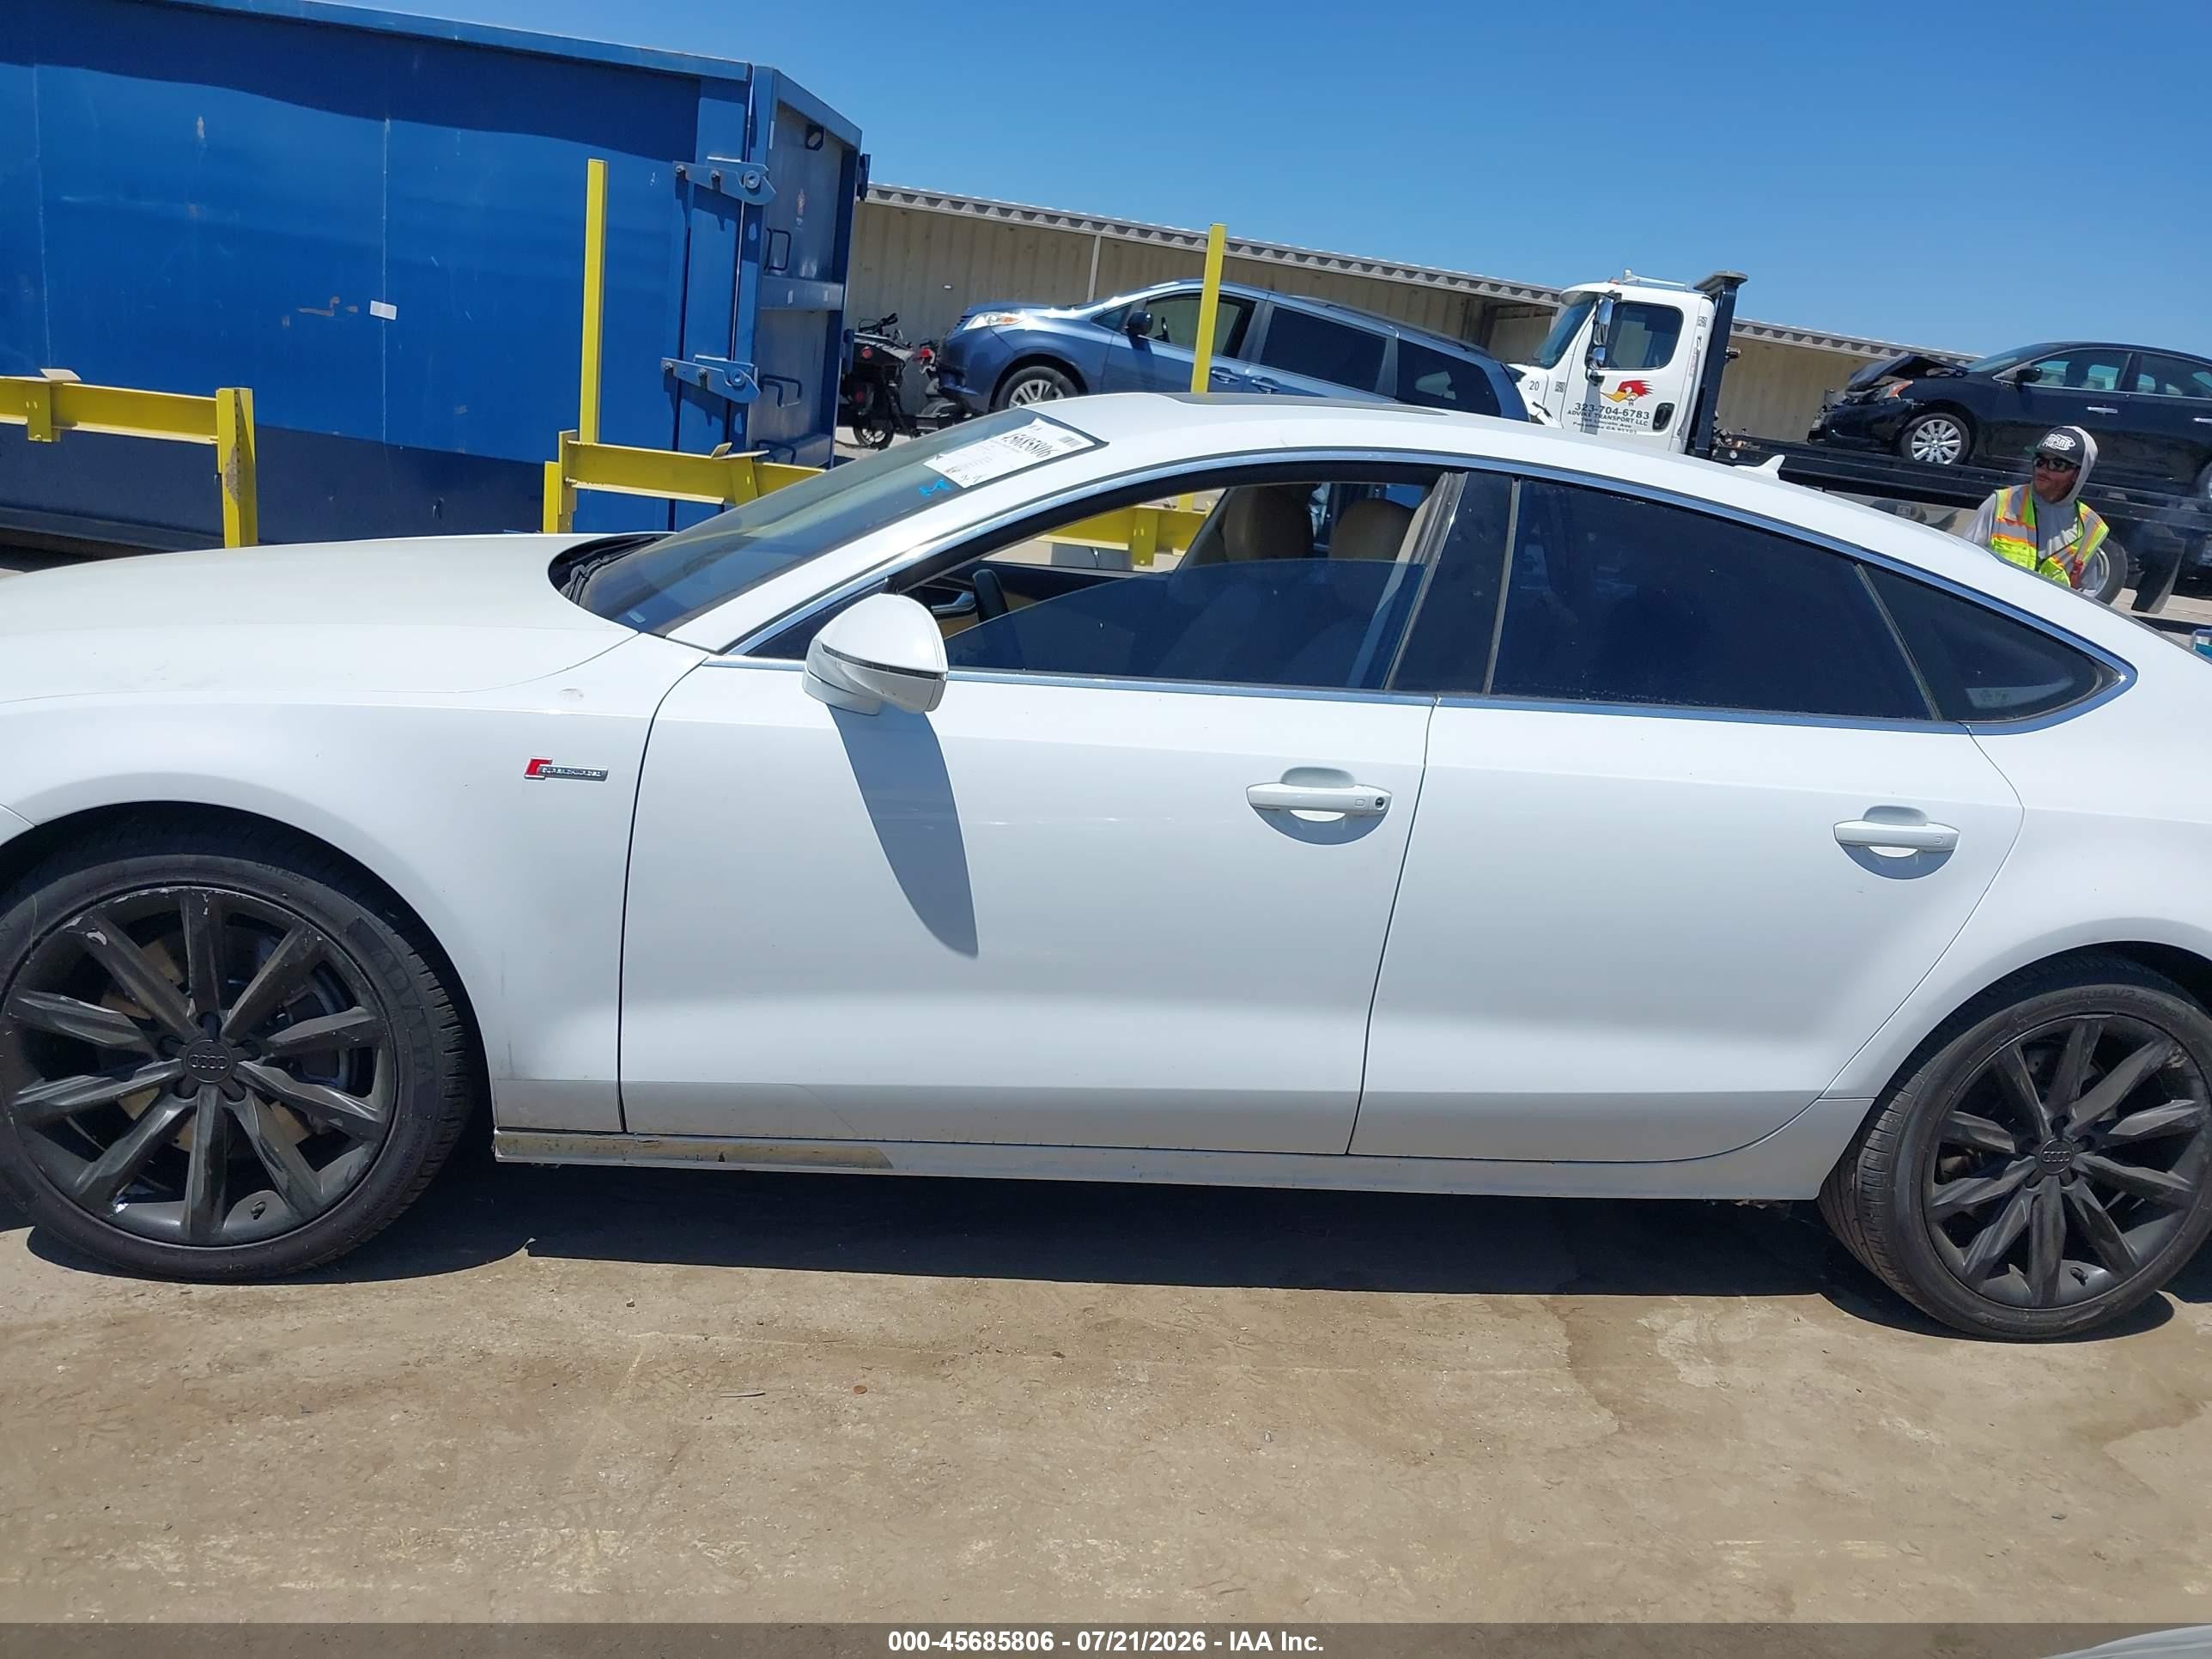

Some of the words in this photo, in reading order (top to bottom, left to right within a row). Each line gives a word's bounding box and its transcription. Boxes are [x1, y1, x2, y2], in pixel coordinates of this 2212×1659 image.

[1528, 380, 1540, 391] 20
[1574, 402, 1650, 419] 323-704-6783
[1594, 412, 1635, 423] TRANSPORT
[1635, 418, 1649, 427] LLC
